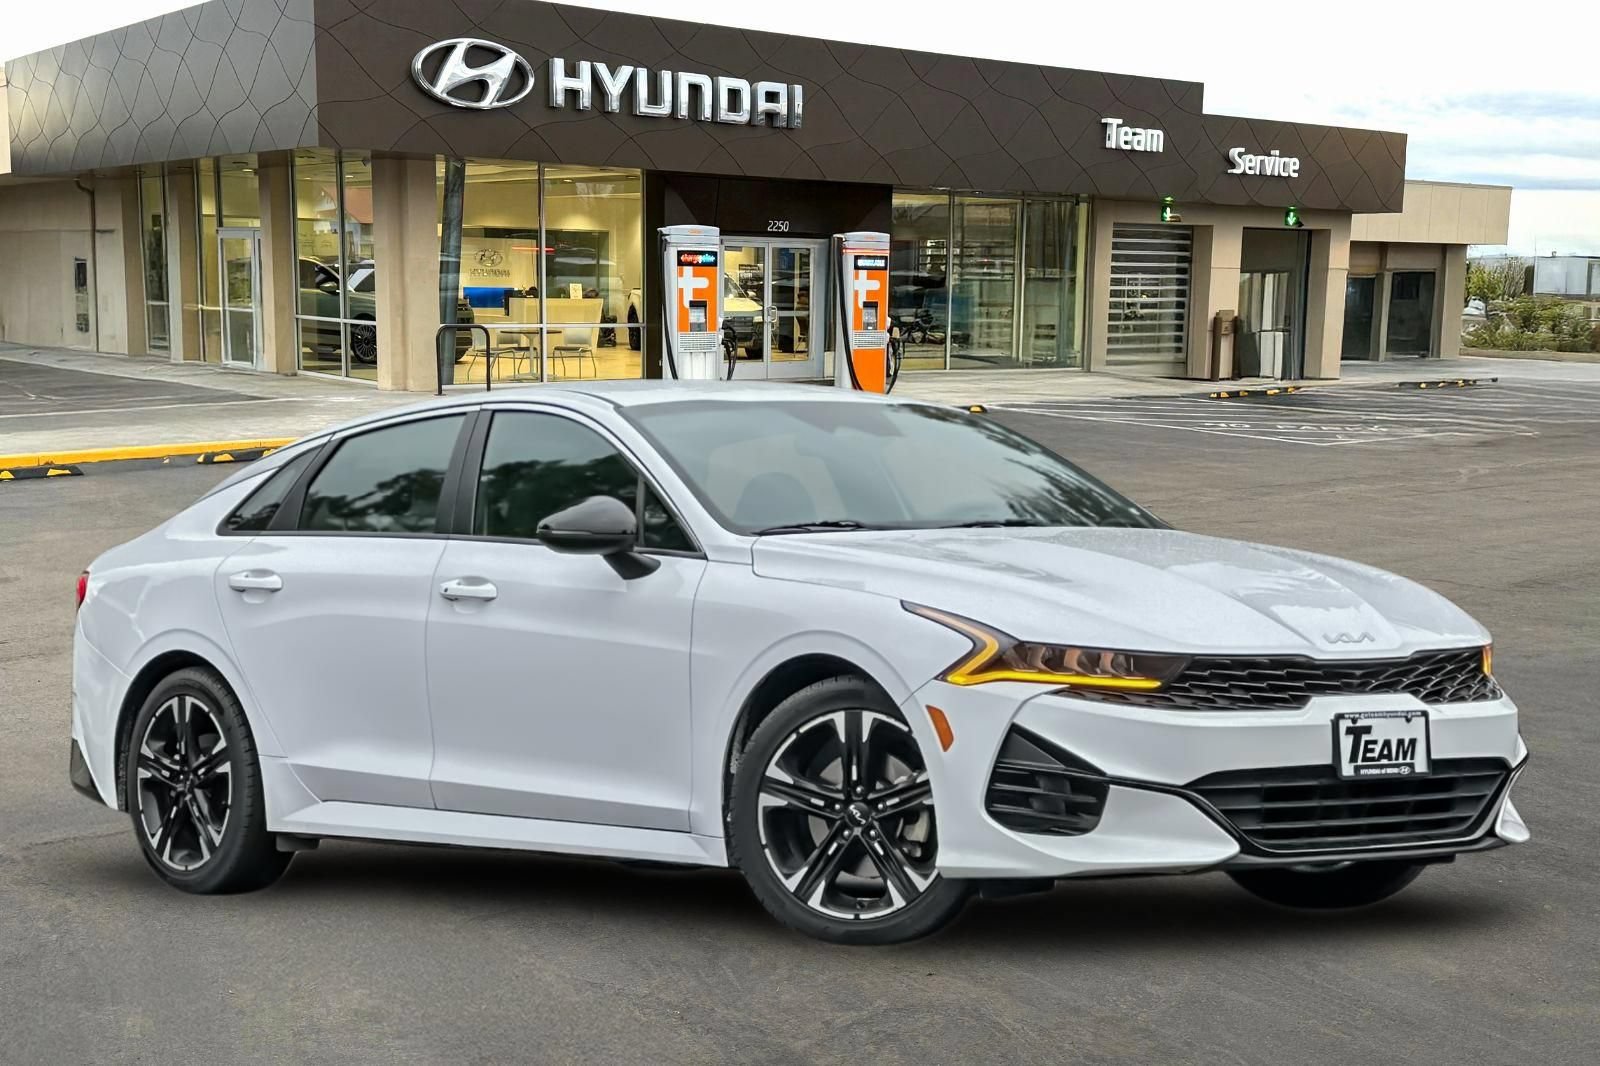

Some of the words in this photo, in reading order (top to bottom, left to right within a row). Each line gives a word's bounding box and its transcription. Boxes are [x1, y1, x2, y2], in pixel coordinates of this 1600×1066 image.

[548, 57, 803, 129] HYUNDAI
[1101, 117, 1164, 153] Team
[1227, 147, 1300, 178] Service
[767, 220, 790, 232] 2250
[1344, 725, 1418, 764] TEAM
